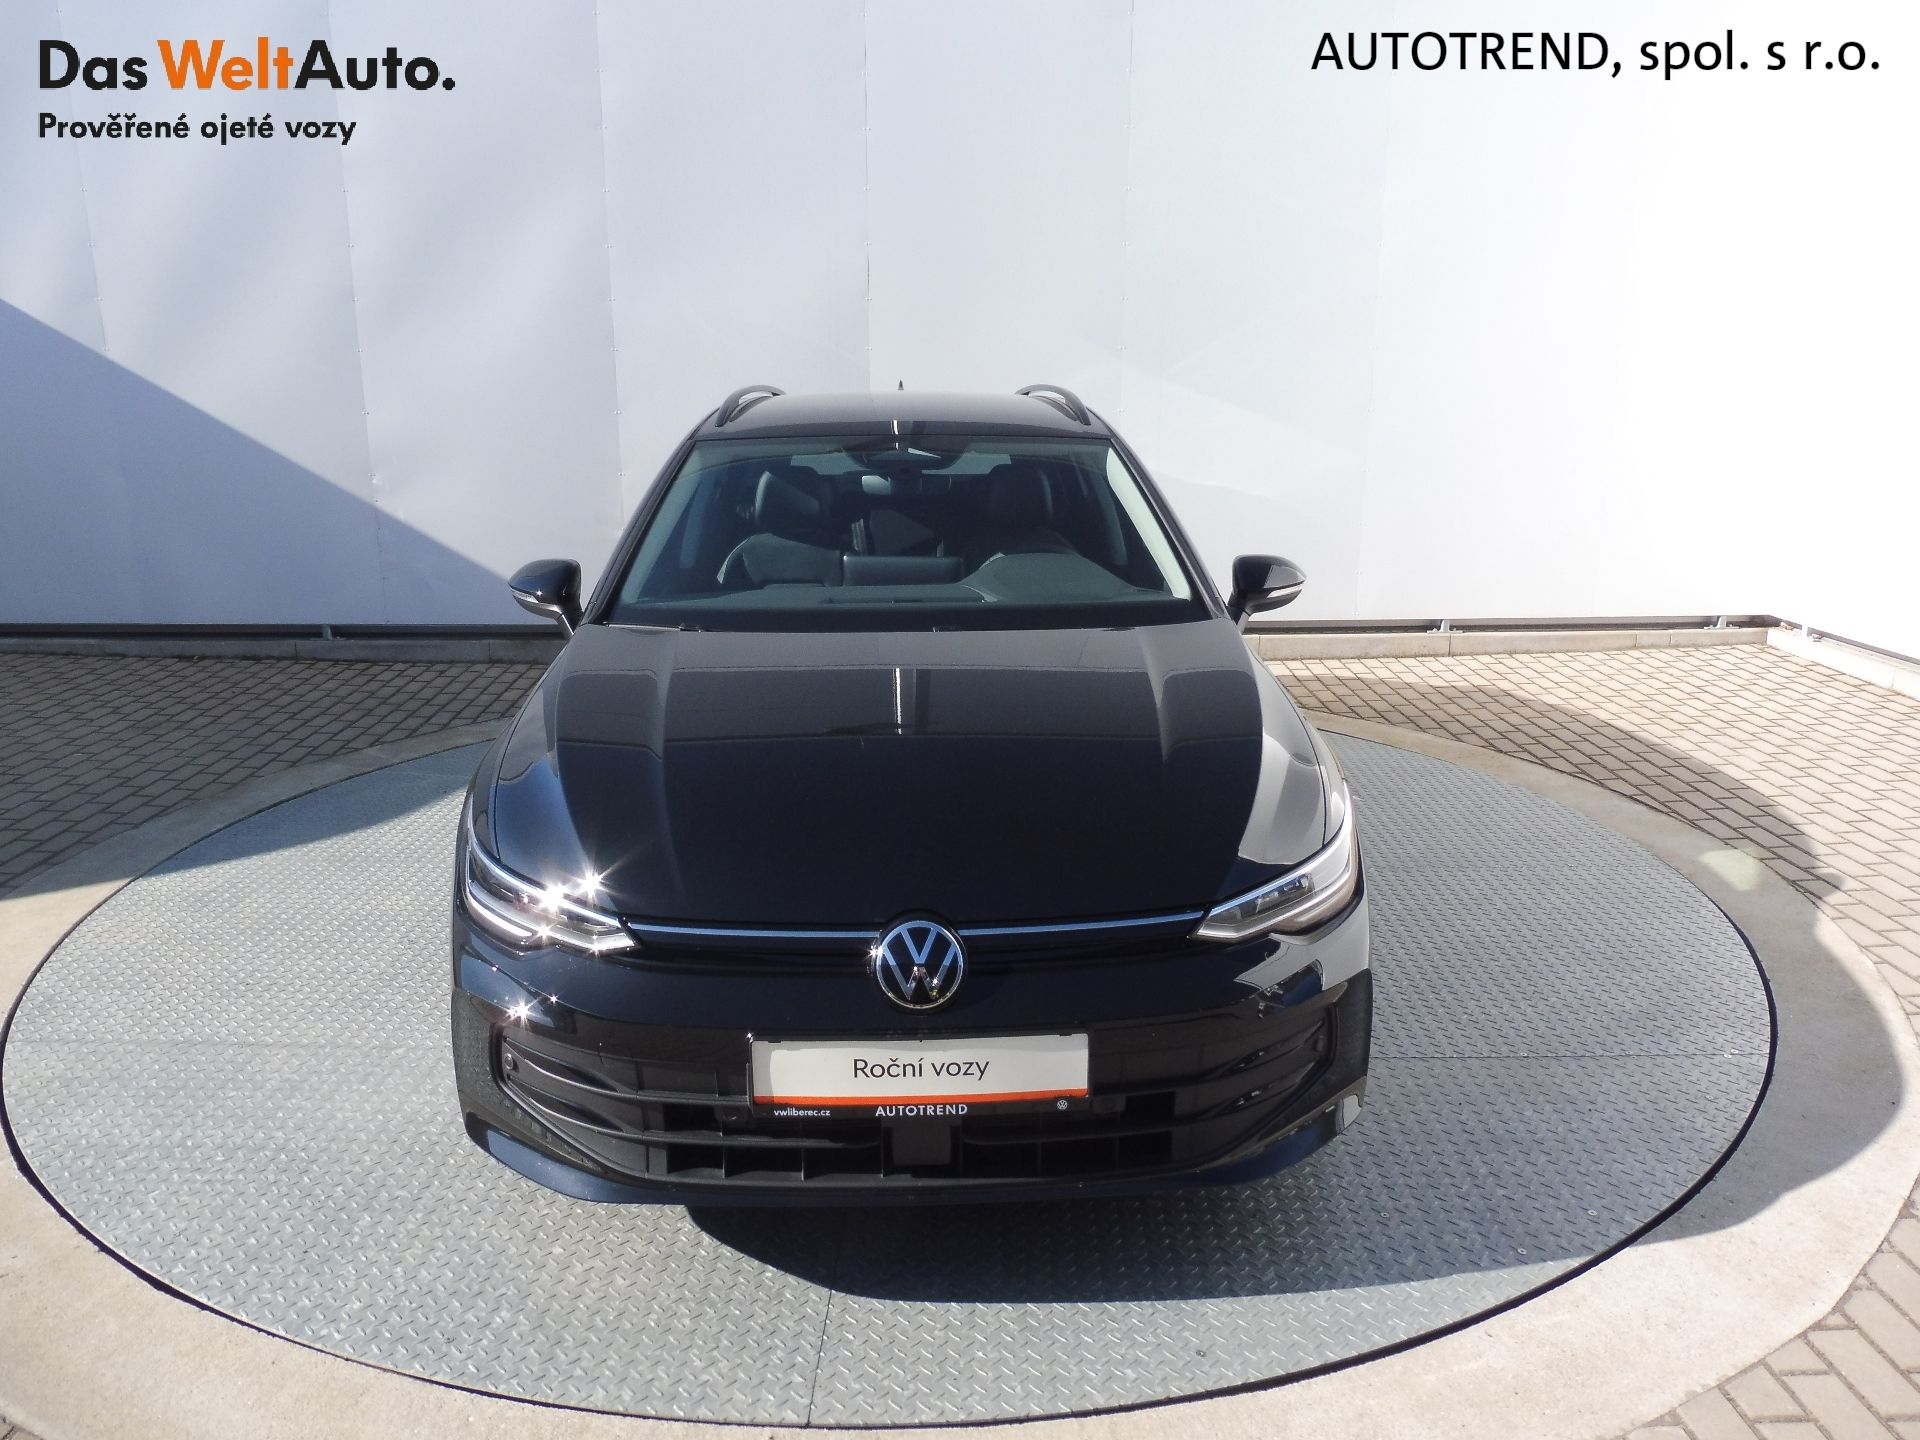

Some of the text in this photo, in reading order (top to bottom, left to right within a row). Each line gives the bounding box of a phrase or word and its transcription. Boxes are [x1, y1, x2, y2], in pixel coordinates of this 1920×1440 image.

[852, 1057, 990, 1081] Roční vozy
[773, 1106, 831, 1116] vwliberec.cz
[875, 1103, 968, 1117] AUTOTREND
